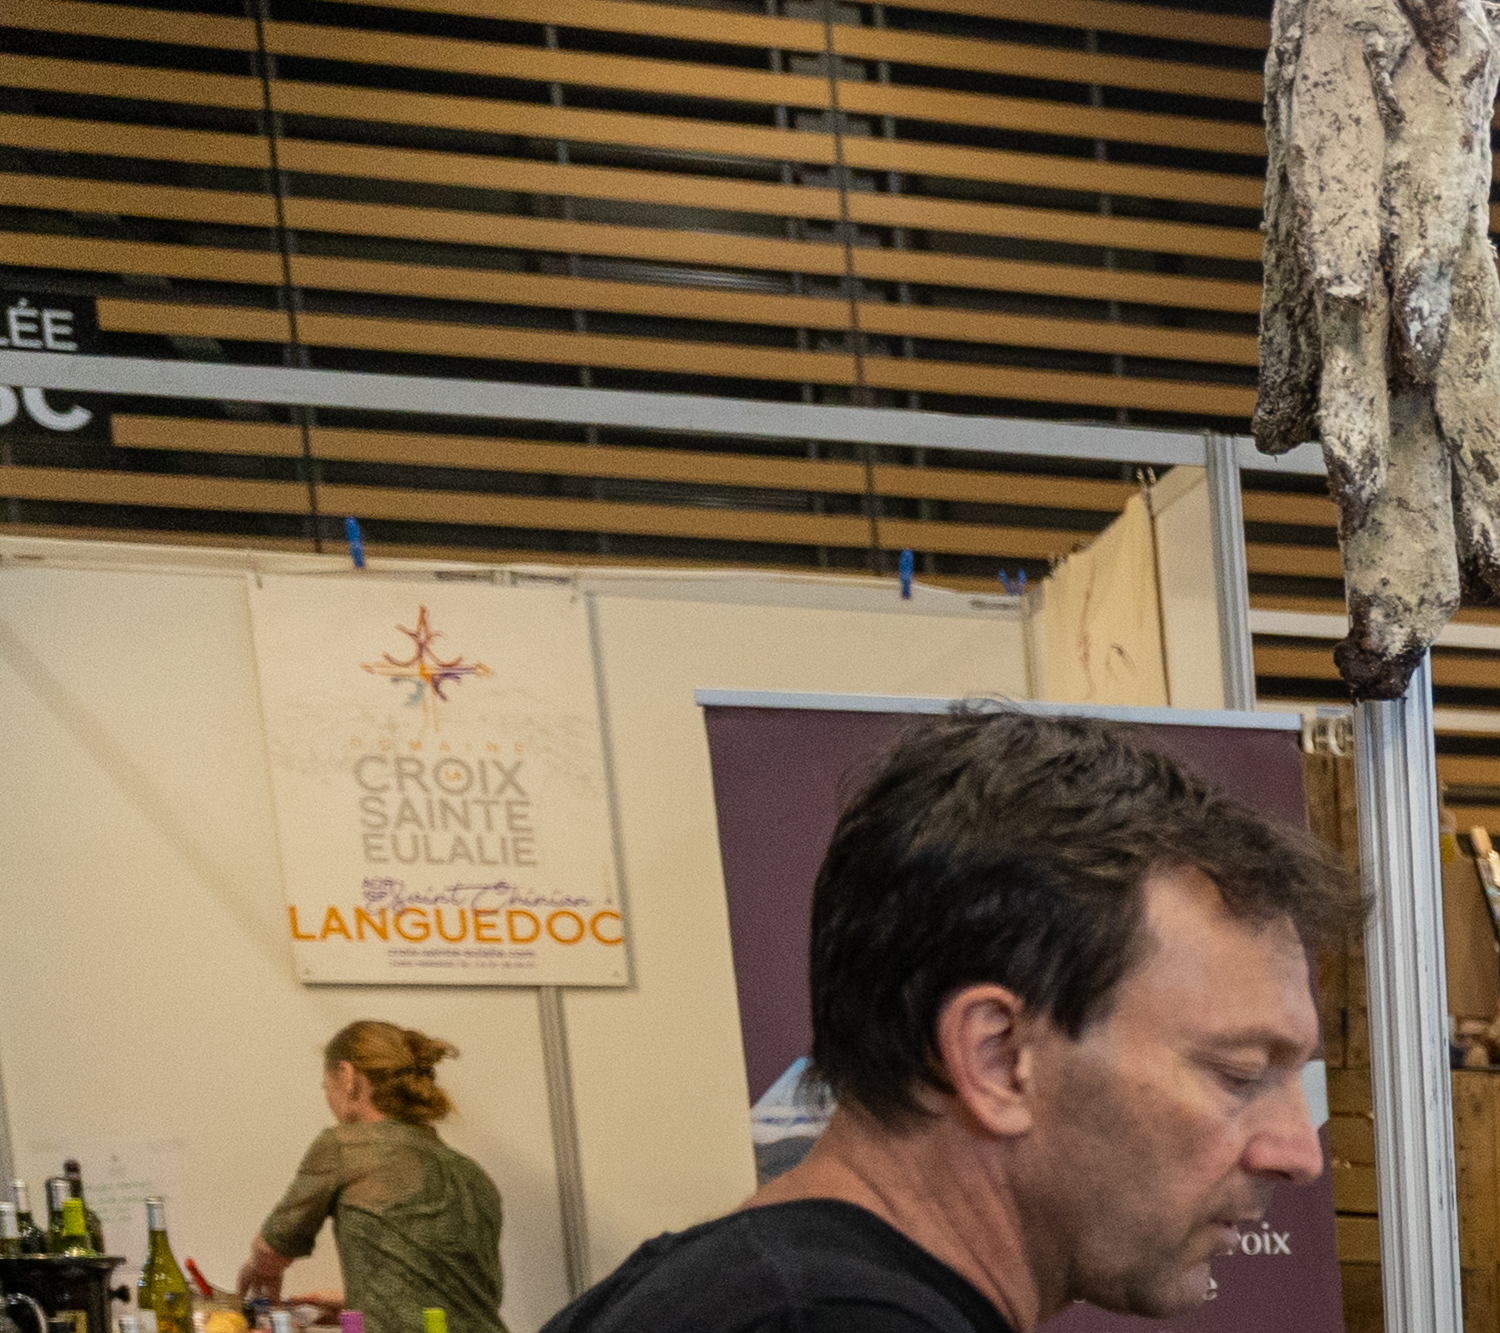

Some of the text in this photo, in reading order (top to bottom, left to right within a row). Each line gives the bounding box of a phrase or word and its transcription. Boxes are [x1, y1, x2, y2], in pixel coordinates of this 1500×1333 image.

[0, 298, 78, 351] ÉE
[353, 753, 530, 799] CROIX
[360, 795, 535, 834] SAINTE
[362, 832, 539, 867] EULALIE
[287, 904, 625, 946] LANGUEDOC
